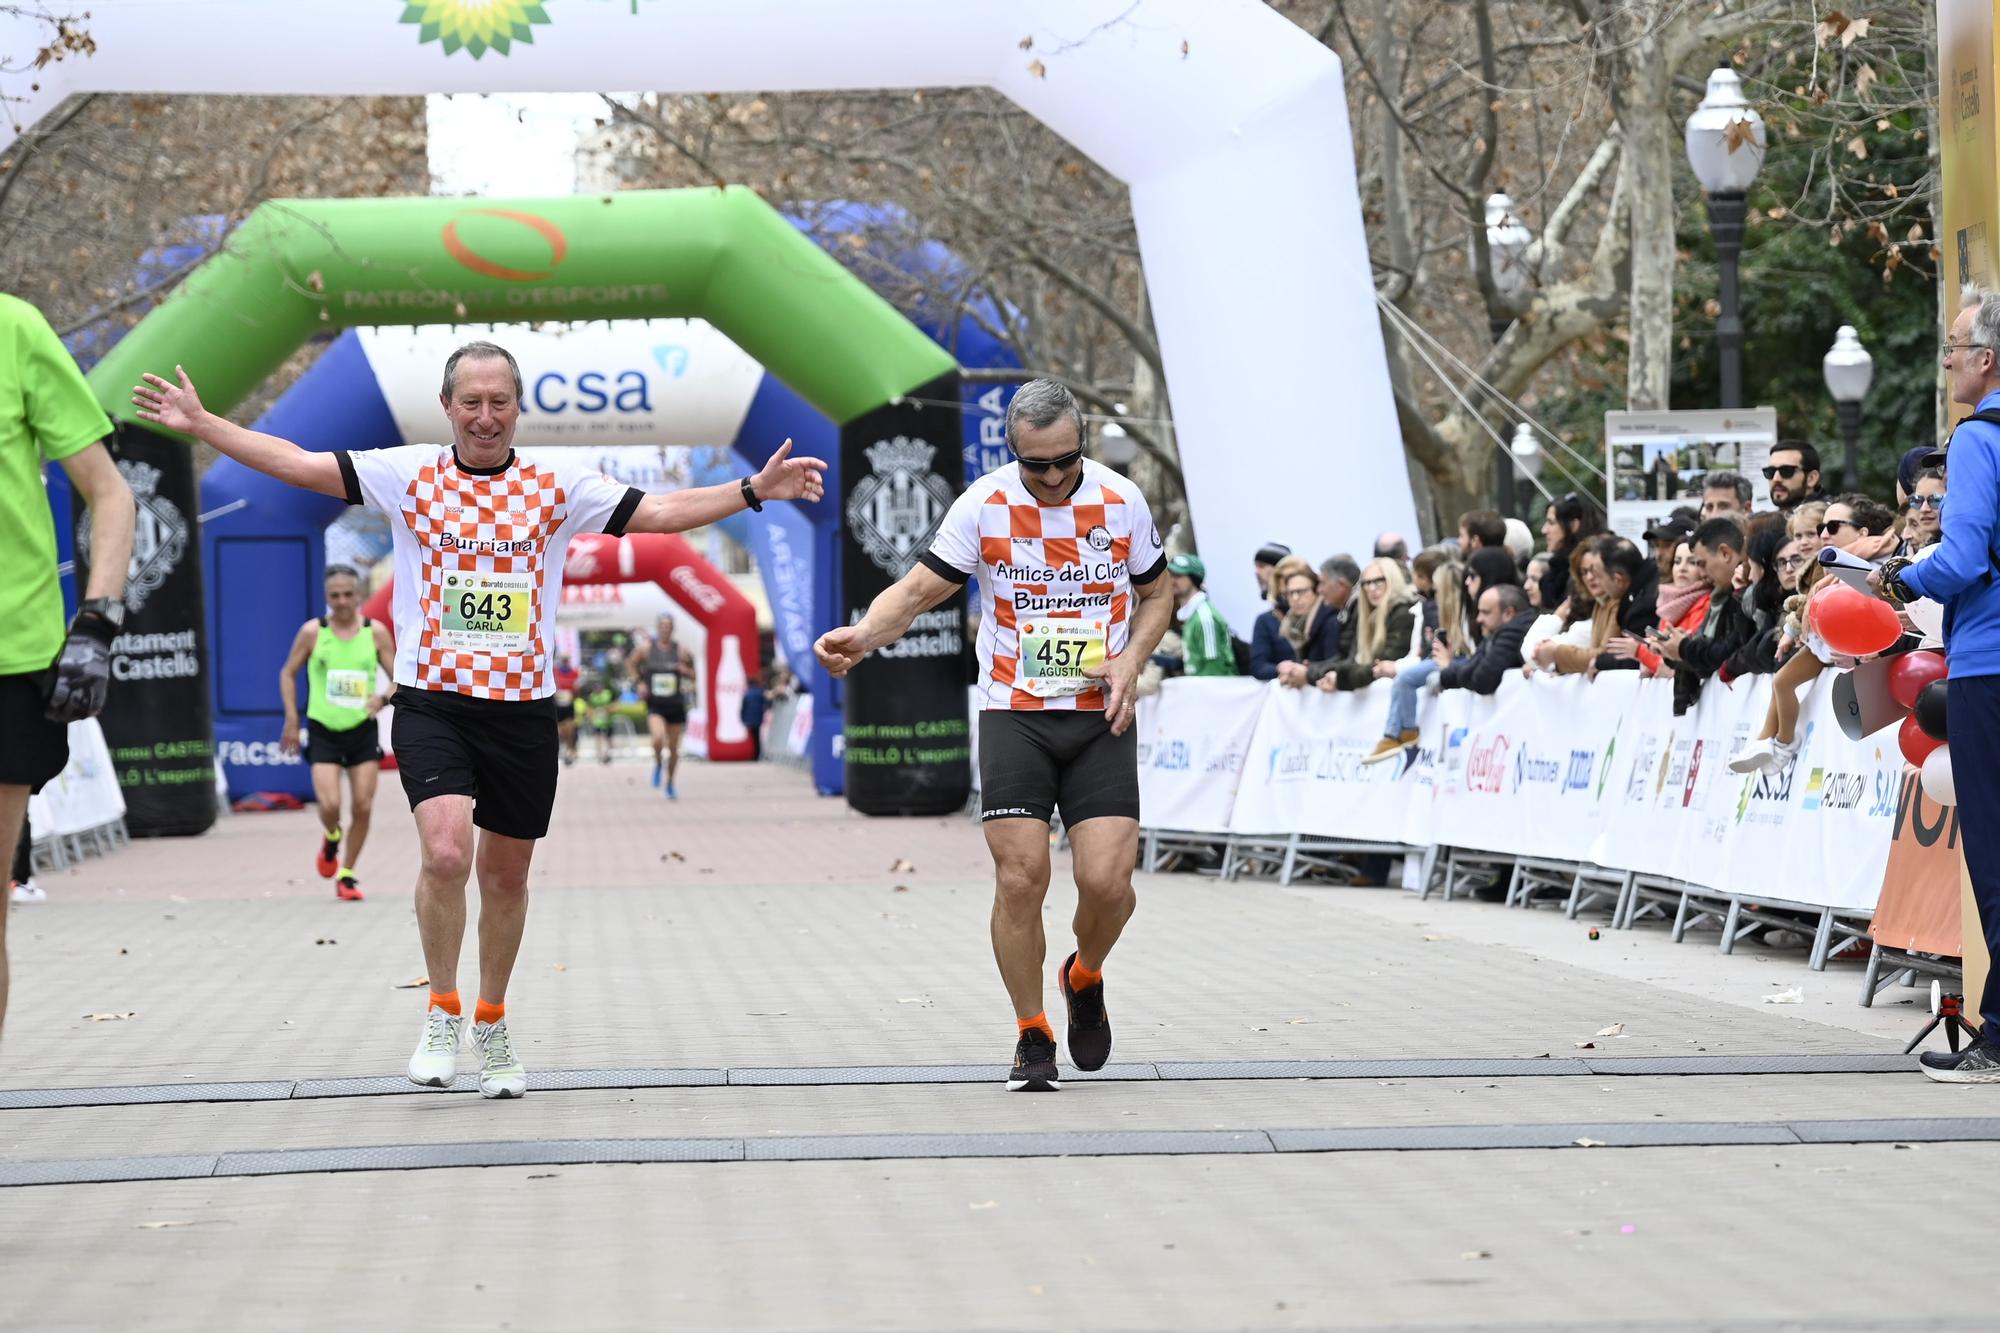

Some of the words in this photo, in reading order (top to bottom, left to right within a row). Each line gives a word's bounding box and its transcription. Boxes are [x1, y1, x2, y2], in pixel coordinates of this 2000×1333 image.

[439, 532, 533, 552] Burriana
[996, 563, 1055, 581] Amics
[1060, 565, 1090, 582] del
[1095, 563, 1125, 580] Clot
[460, 592, 512, 621] 643
[1014, 592, 1111, 610] Burriana
[466, 620, 504, 632] CARLA
[1036, 639, 1088, 667] 457
[111, 648, 199, 680] Castelló
